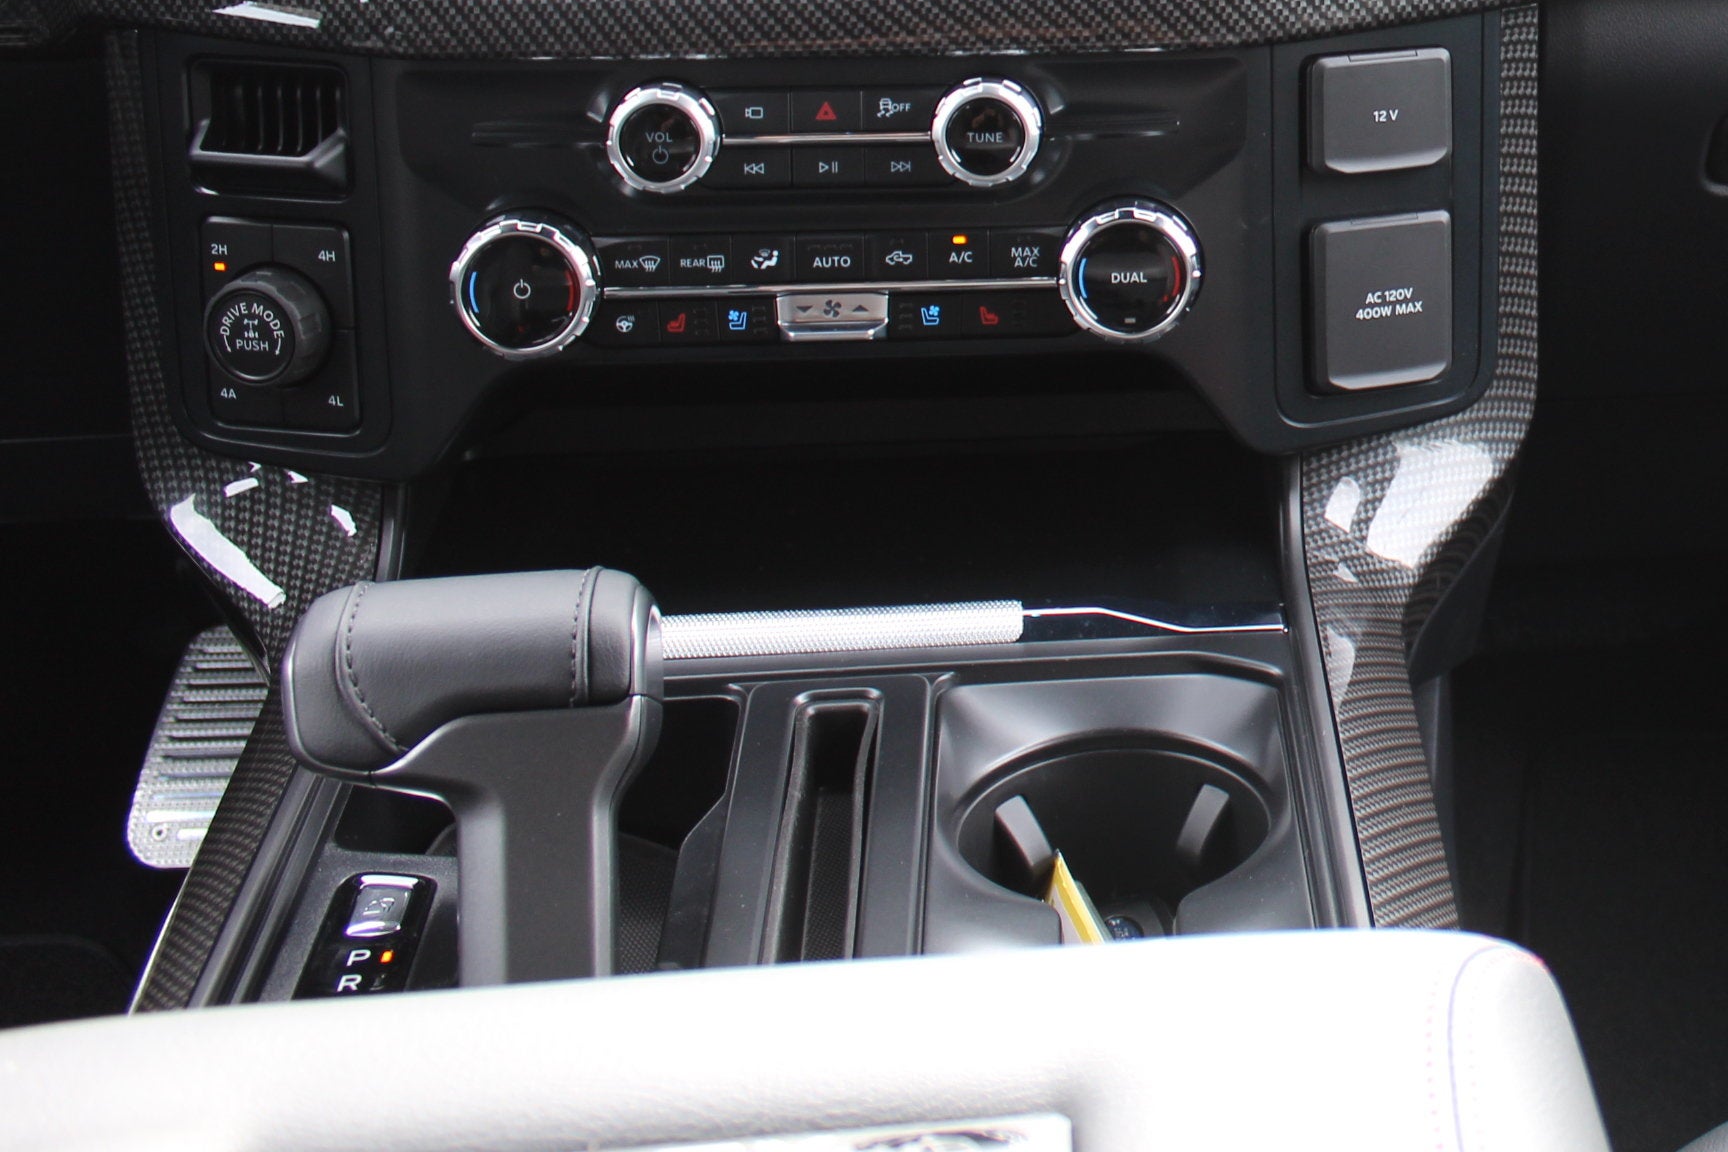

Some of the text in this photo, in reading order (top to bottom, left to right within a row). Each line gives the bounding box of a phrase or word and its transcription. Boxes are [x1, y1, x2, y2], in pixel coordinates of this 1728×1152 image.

[892, 102, 911, 113] OFF
[1373, 109, 1399, 122] 12 V
[645, 131, 673, 143] VOL
[966, 131, 1003, 143] TUNE
[211, 243, 228, 255] 2H
[1011, 246, 1040, 258] MAX
[318, 250, 336, 262] 4H
[813, 256, 851, 268] AUTO
[949, 250, 973, 264] A/C
[615, 260, 639, 269] MAX
[680, 259, 706, 268] REAR
[1014, 257, 1038, 269] A/C
[1111, 272, 1148, 284] DUAL
[1365, 287, 1413, 305] AC 120V
[1355, 300, 1423, 321] 400W MAX
[220, 302, 285, 339] DRIVE MODE
[236, 339, 269, 351] PUSH
[220, 387, 237, 399] 4A
[328, 395, 344, 407] 4L
[346, 949, 371, 967] P
[336, 974, 362, 992] R
